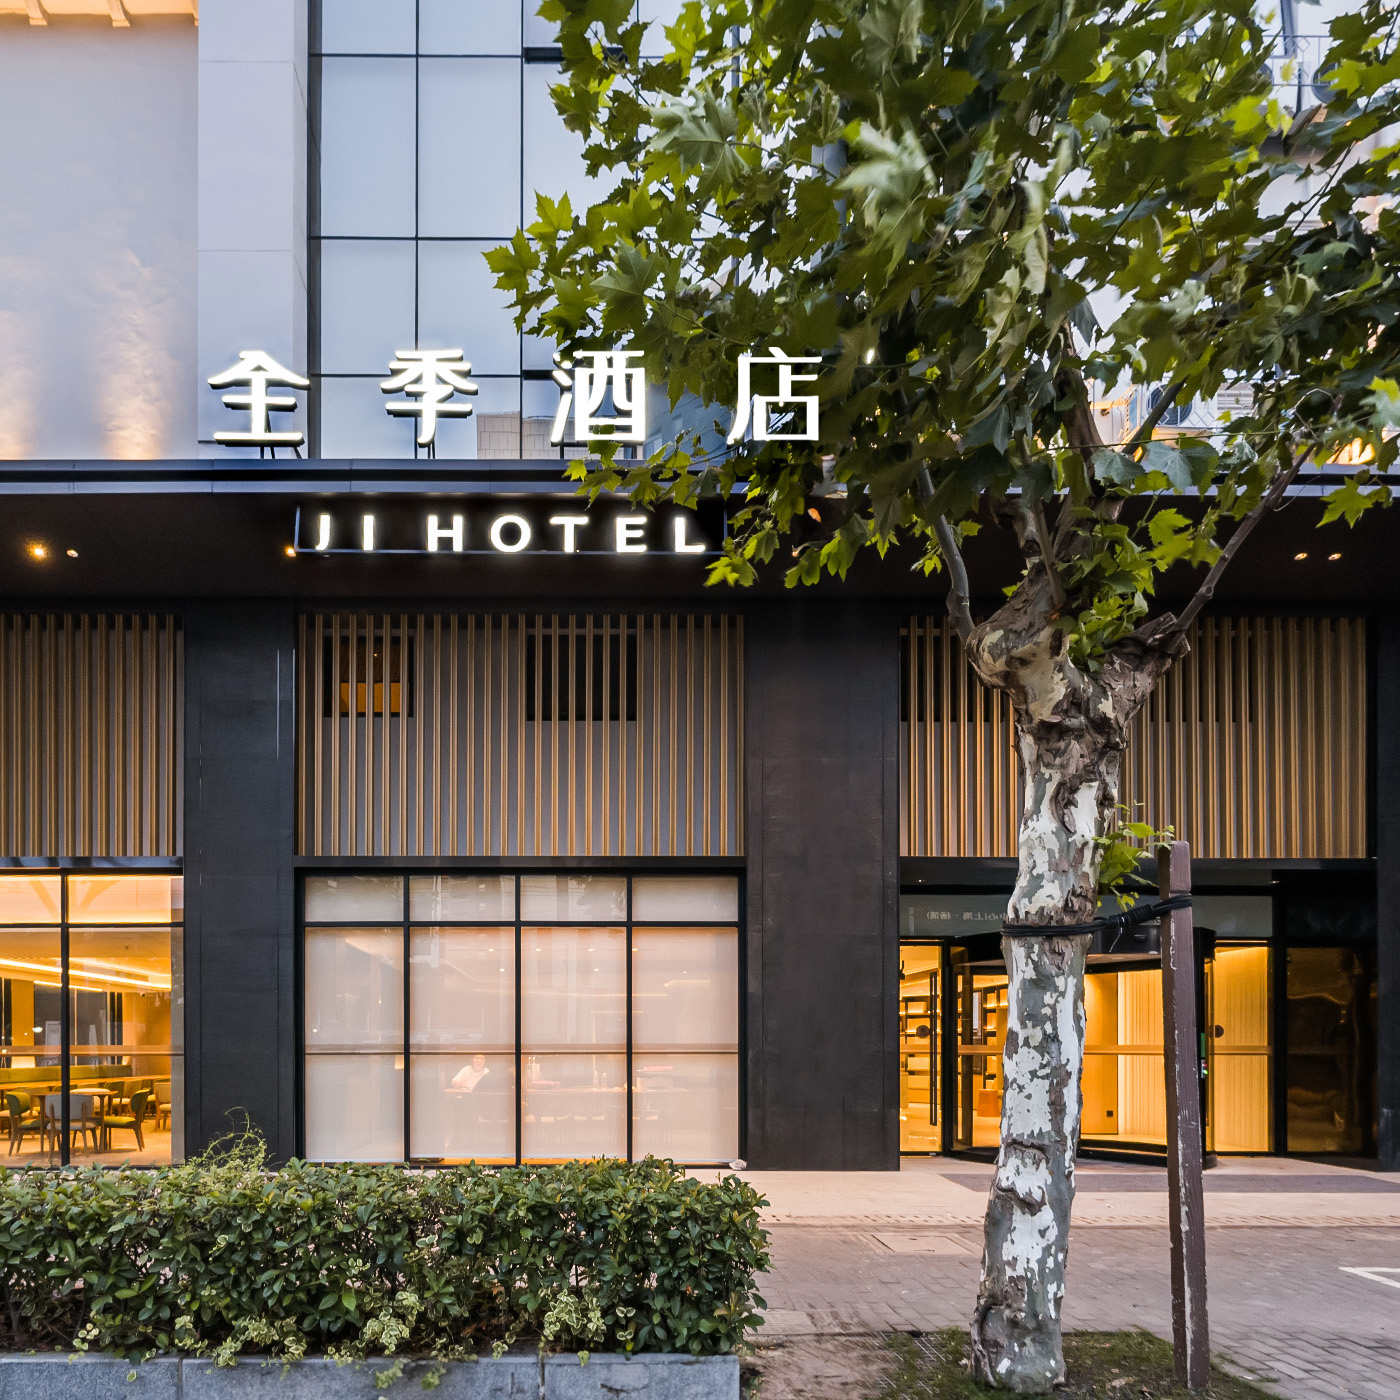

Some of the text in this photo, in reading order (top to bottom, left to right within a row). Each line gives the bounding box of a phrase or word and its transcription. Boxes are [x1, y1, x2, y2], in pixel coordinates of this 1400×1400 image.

[207, 347, 822, 447] 全季酒店
[315, 514, 706, 553] JI HOTEL
